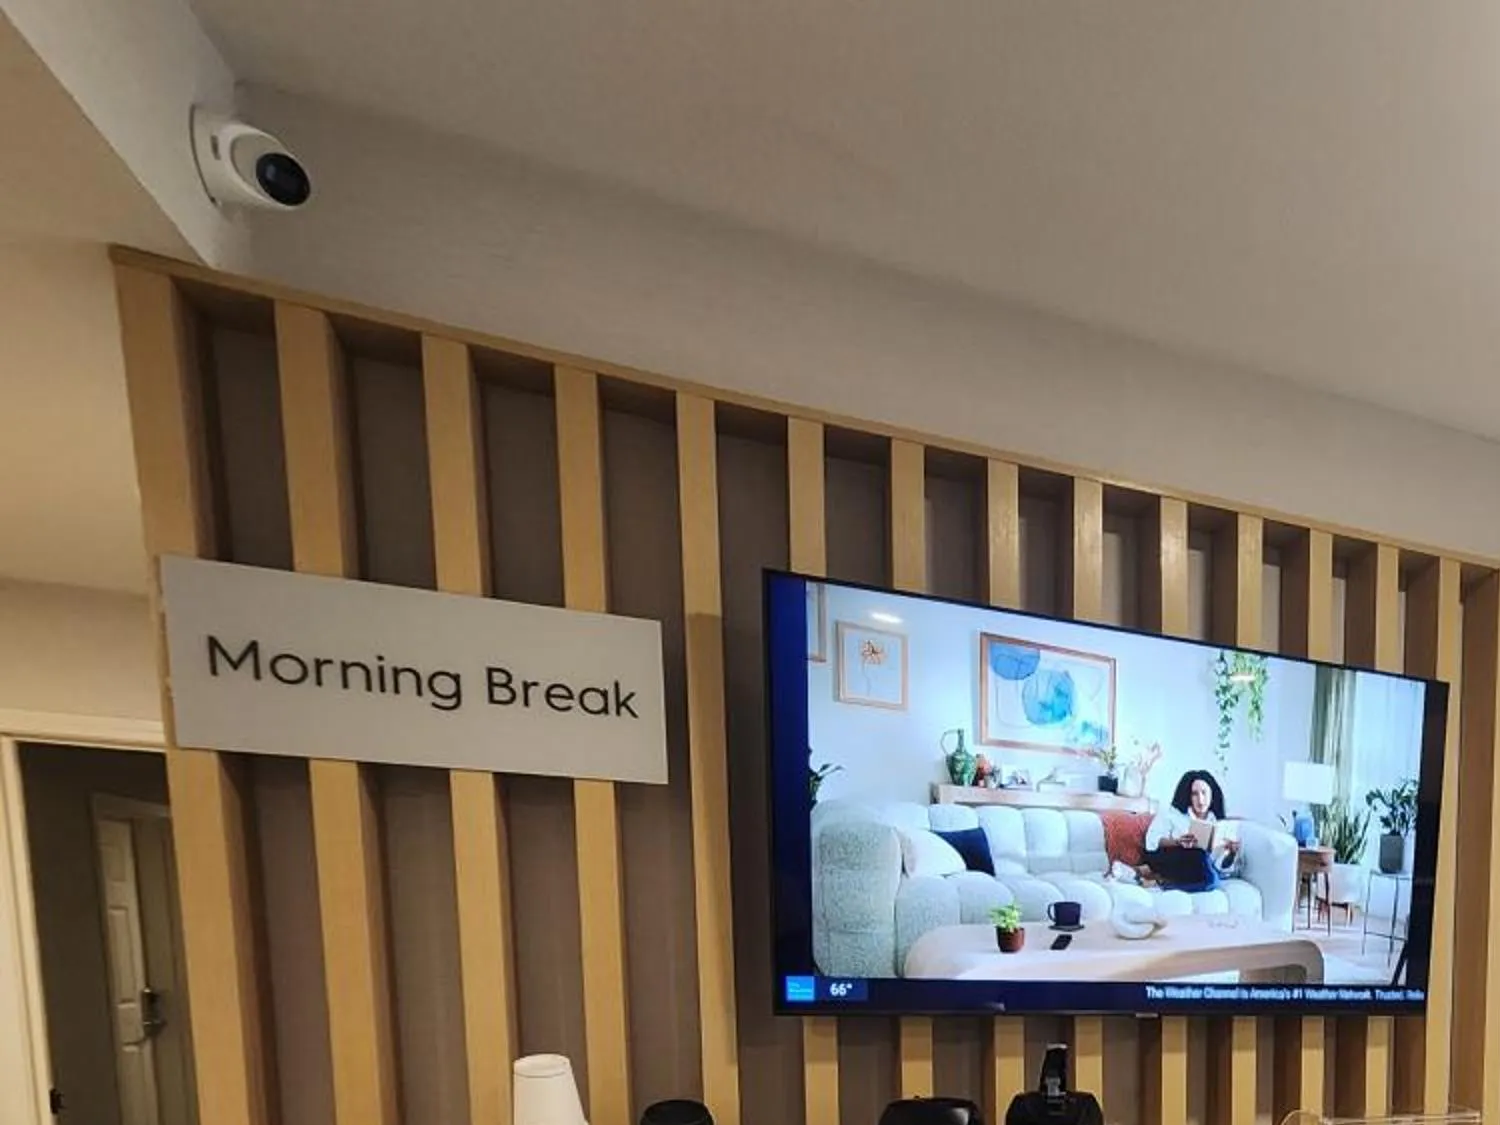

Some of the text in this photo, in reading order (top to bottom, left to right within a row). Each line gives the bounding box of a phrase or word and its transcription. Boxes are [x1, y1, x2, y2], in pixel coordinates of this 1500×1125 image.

[206, 634, 640, 720] Morning Break
[1146, 985, 1164, 999] The
[1165, 985, 1202, 999] Weather
[1203, 985, 1239, 999] Channel
[1304, 987, 1338, 1000] Weather
